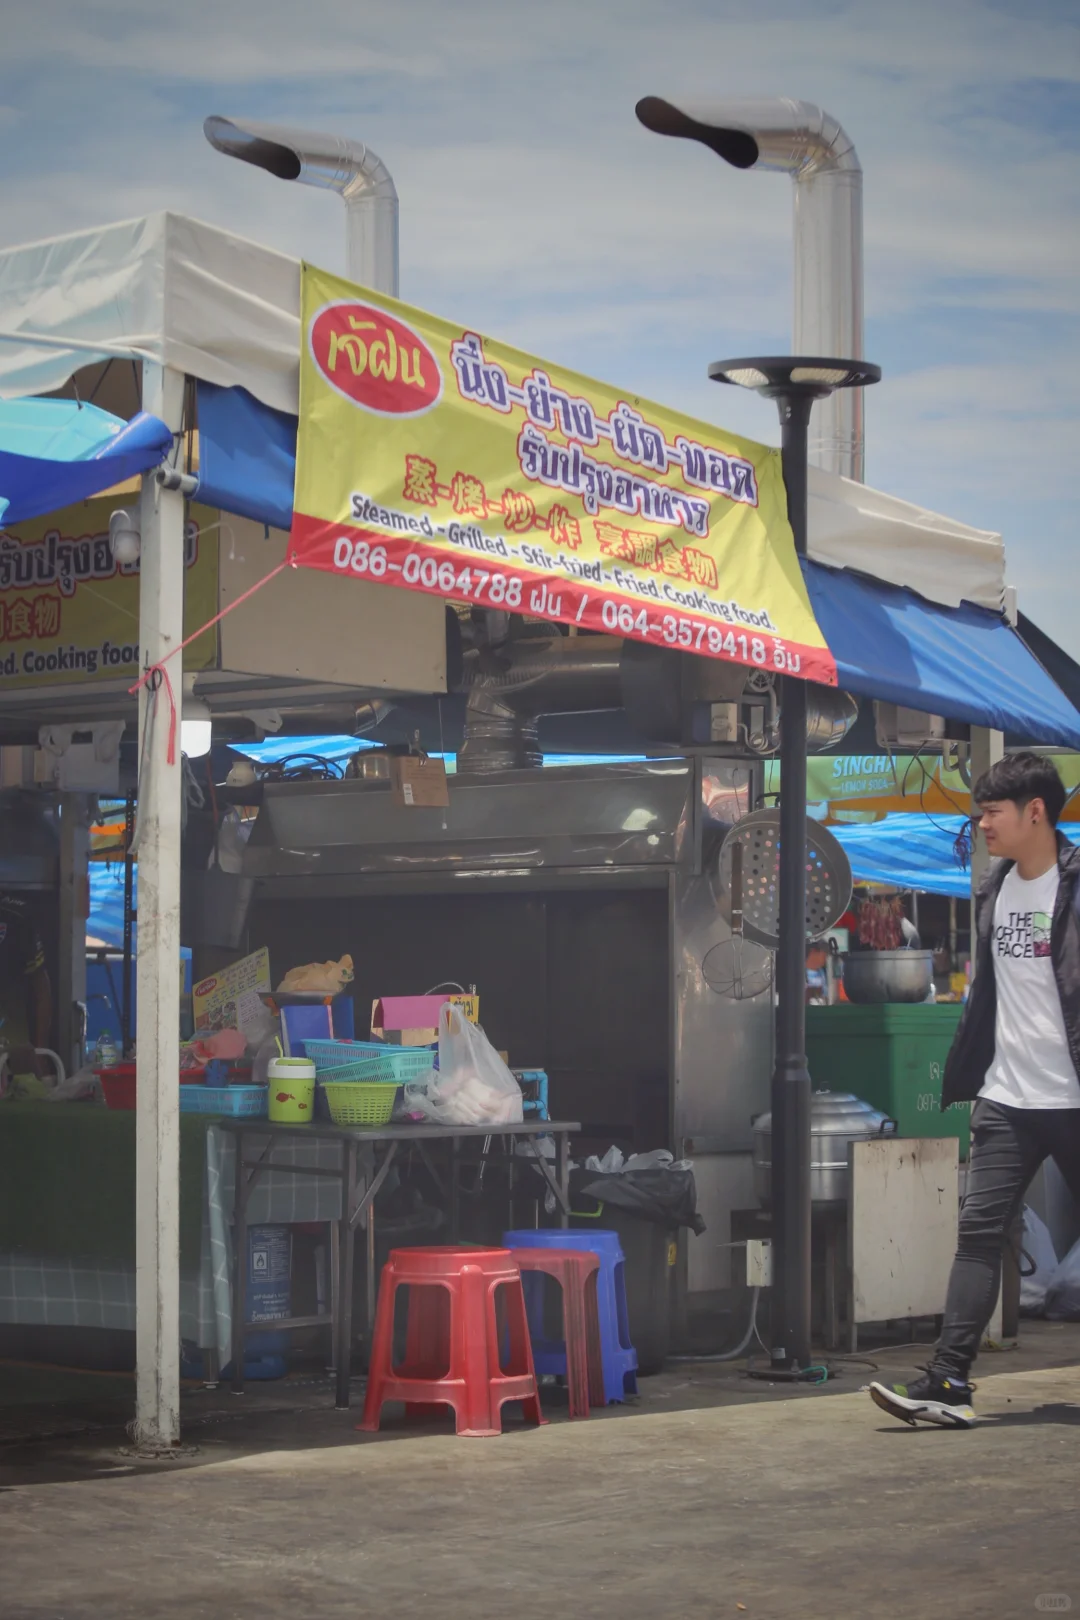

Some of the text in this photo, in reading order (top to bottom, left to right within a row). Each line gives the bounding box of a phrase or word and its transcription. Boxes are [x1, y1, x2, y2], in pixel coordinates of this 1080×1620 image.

[521, 426, 708, 534] รับปรุงอาหาร
[352, 495, 433, 537] Steamed
[449, 523, 507, 557] Grilled
[521, 545, 602, 583] Stir-fried
[615, 570, 663, 599] Fried.
[664, 586, 730, 622] Cooking
[733, 602, 776, 631] food.
[333, 537, 523, 607] 086-0064788
[530, 584, 562, 617] ฝน
[602, 600, 766, 664] 064-3579418
[23, 645, 97, 673] Cooking
[832, 755, 897, 778] SINGHA
[1009, 912, 1032, 927] THE
[997, 942, 1032, 958] FACE
